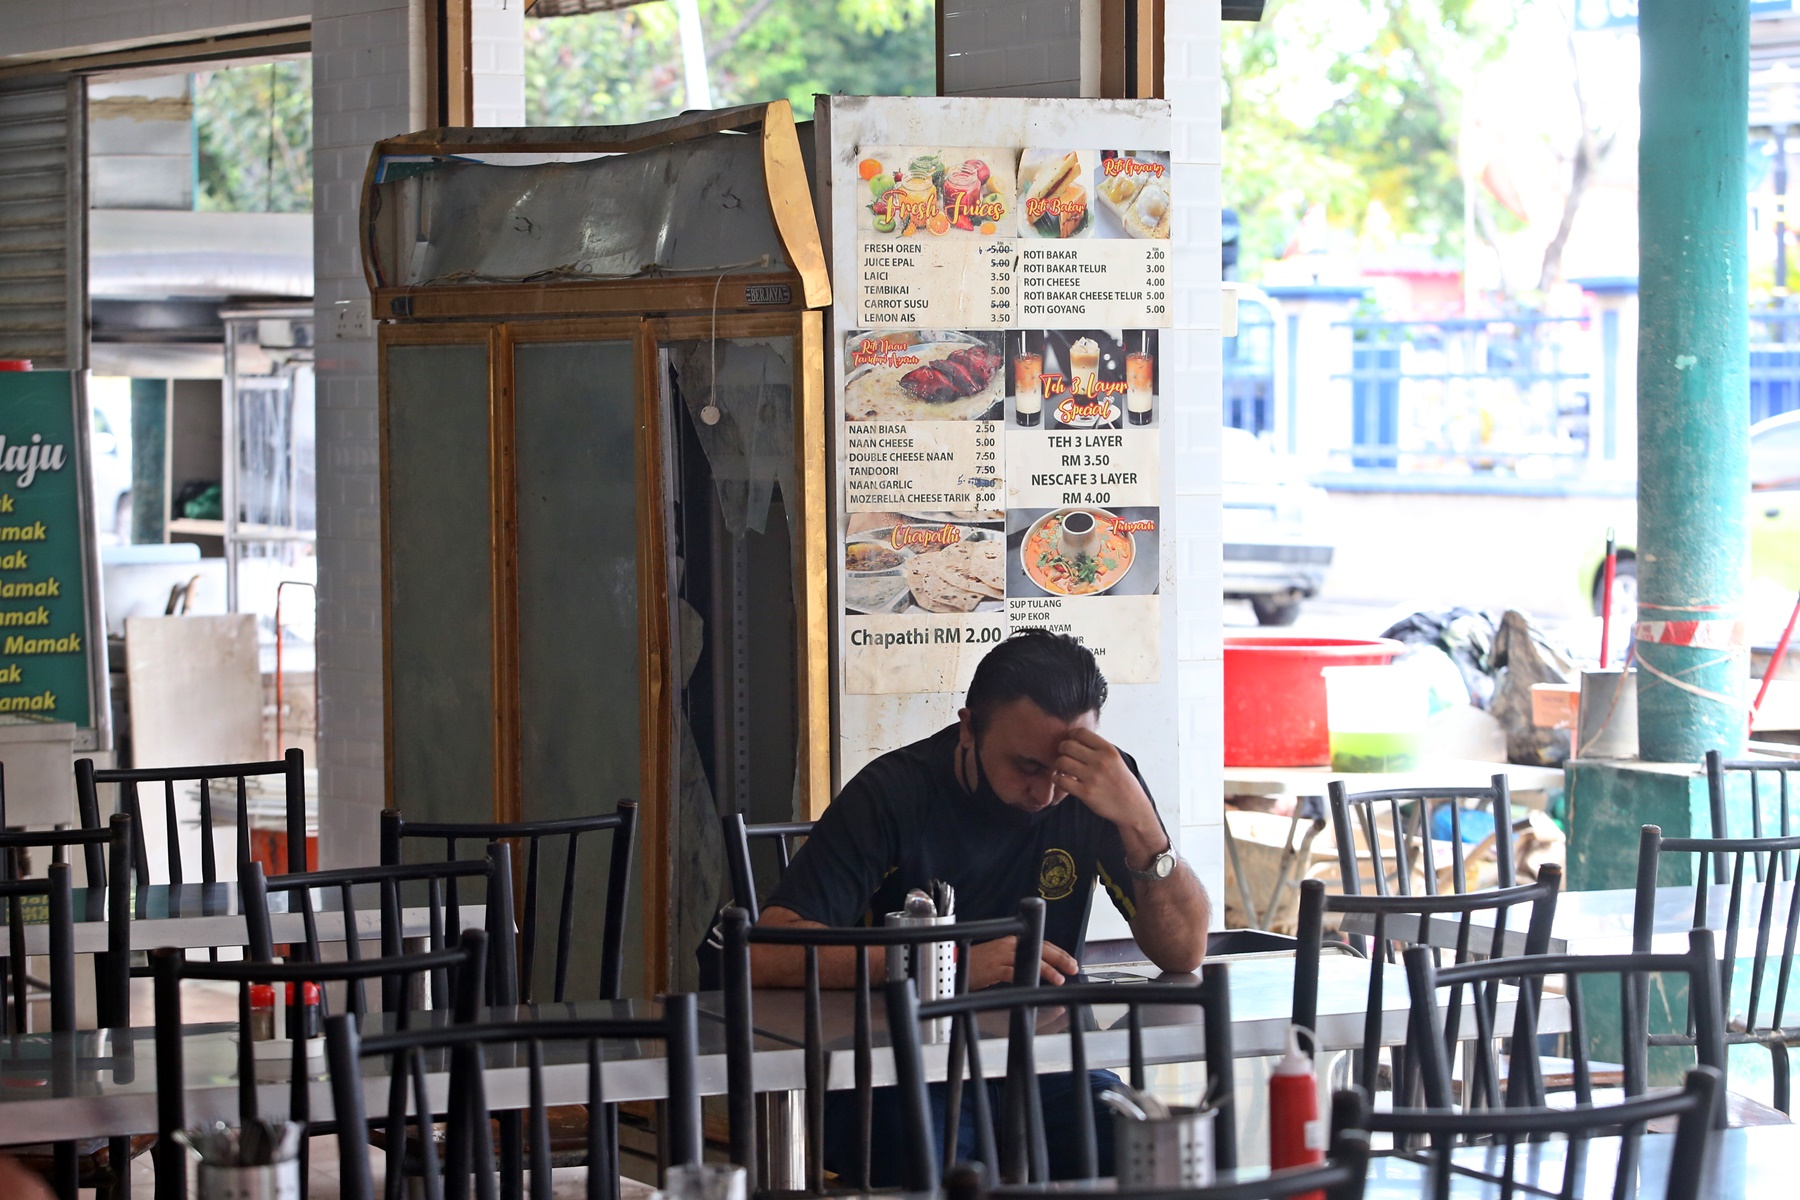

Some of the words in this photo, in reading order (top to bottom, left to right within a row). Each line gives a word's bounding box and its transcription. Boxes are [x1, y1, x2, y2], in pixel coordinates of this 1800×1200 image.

[882, 189, 939, 224] Fresh
[945, 191, 1004, 225] Juices
[1050, 198, 1086, 216] Bakar
[864, 244, 894, 253] FRESH
[896, 244, 922, 253] OREN
[1023, 250, 1044, 259] ROTI
[1047, 251, 1077, 259] BAKAR
[1146, 251, 1165, 260] 2.00
[864, 258, 890, 267] JUICE
[892, 258, 914, 267] EPAL
[1023, 264, 1044, 273] ROTI
[1047, 264, 1077, 273] BAKAR
[1079, 264, 1107, 273] TELUR
[1146, 265, 1165, 273] 3.00
[864, 272, 888, 280] LAICI
[991, 272, 1010, 281] 3.50
[1024, 278, 1044, 286] ROTI
[1047, 278, 1080, 286] CHEESE
[1146, 278, 1165, 286] 4.00
[750, 288, 784, 302] BERJAYA
[864, 286, 909, 294] TEMBIKAI
[991, 286, 1010, 295] 5.00
[1024, 292, 1044, 300] ROTI
[1047, 292, 1078, 300] BAKAR
[1079, 292, 1113, 300] CHEESE
[1115, 292, 1143, 300] TELUR
[1146, 292, 1165, 300] 5.00
[864, 300, 902, 308] CARROT
[904, 300, 928, 308] SUSU
[1024, 305, 1045, 314] ROTI
[1047, 305, 1086, 314] GOYANG
[1146, 305, 1165, 314] 5.00
[864, 313, 898, 322] LEMON
[900, 313, 916, 322] AIS
[991, 314, 1010, 322] 3.50
[1039, 374, 1066, 398] Teh
[1069, 377, 1081, 395] 3
[1086, 373, 1128, 398] Layer
[1058, 398, 1112, 423] Special
[849, 425, 876, 434] NAAN
[879, 425, 906, 434] BIASA
[976, 424, 995, 433] 2.50
[849, 439, 877, 448] NAAN
[879, 439, 914, 448] CHEESE
[976, 438, 995, 447] 5.00
[1048, 436, 1072, 448] TEH
[1075, 436, 1082, 447] 3
[1085, 435, 1123, 447] LAYER
[0, 433, 67, 488] aju
[849, 453, 888, 462] DOUBLE
[889, 452, 924, 462] CHEESE
[926, 452, 954, 461] NAAN
[976, 452, 995, 460] 7.50
[1061, 455, 1081, 466] RM
[1084, 454, 1110, 466] 3.50
[849, 466, 899, 476] TANDOORI
[976, 466, 995, 474] 7.50
[1031, 474, 1087, 486] NESCAFE
[1090, 474, 1097, 485] 3
[1100, 473, 1137, 484] LAYER
[849, 480, 877, 490] NAAN
[879, 480, 913, 489] GARLIC
[850, 494, 905, 504] MOZERELLA
[907, 494, 943, 503] CHEESE
[944, 494, 970, 502] TARIK
[976, 493, 995, 502] 8.00
[1062, 493, 1081, 504] RM
[1084, 492, 1111, 504] 4.00
[0, 520, 46, 540] mak
[890, 523, 961, 550] Chapathi
[0, 550, 28, 569] ak
[0, 577, 60, 598] amak
[1010, 600, 1026, 609] SUP
[1028, 600, 1062, 608] TULANG
[1010, 613, 1026, 621] SUP
[1028, 612, 1050, 620] EKOR
[1048, 624, 1072, 633] AYAM
[4, 632, 81, 654] Mamak
[850, 628, 933, 650] Chapathi
[934, 628, 960, 644] RM
[965, 627, 1002, 644] 2.00
